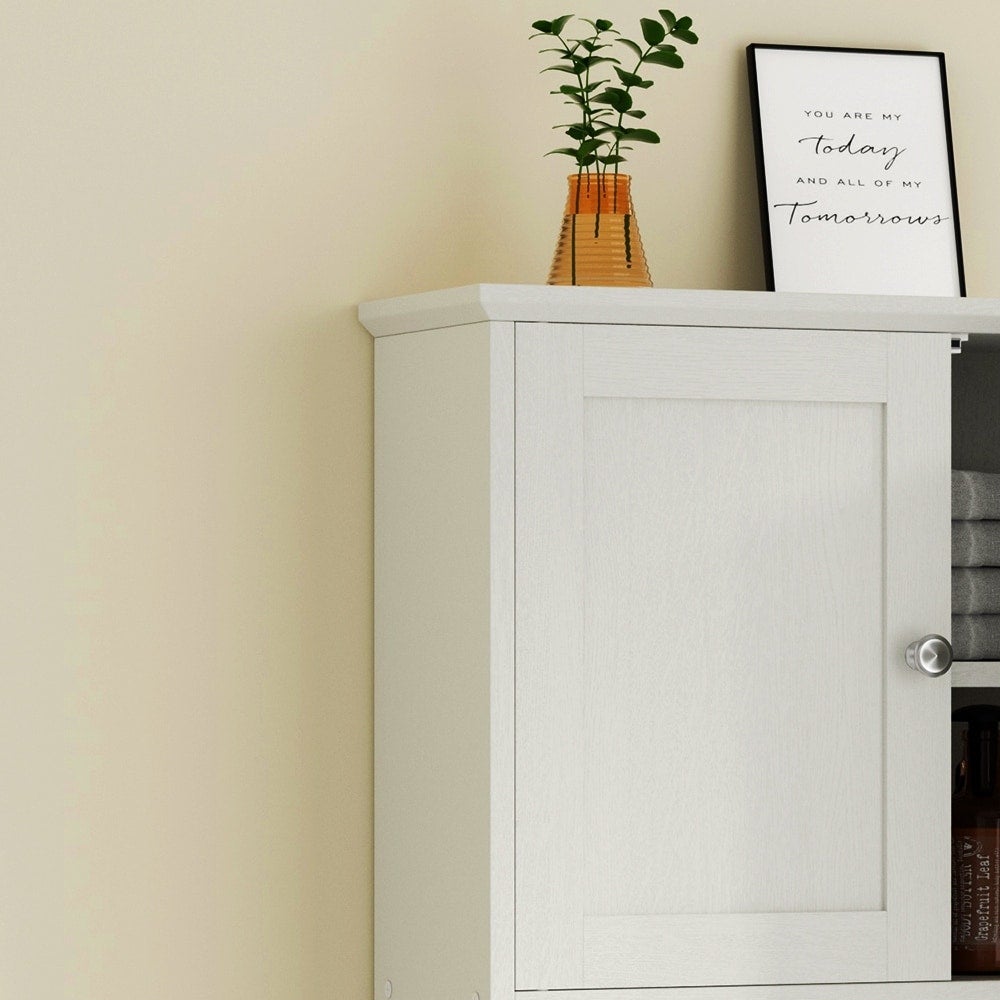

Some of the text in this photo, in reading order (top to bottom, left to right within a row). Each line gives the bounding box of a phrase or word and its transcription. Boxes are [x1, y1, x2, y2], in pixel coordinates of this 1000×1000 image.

[804, 110, 834, 118] YOU
[843, 112, 873, 120] ARE
[796, 177, 828, 185] AND
[874, 179, 893, 187] OF
[773, 200, 950, 226] Tomorrows
[974, 853, 992, 941] Grapefruit Leaf
